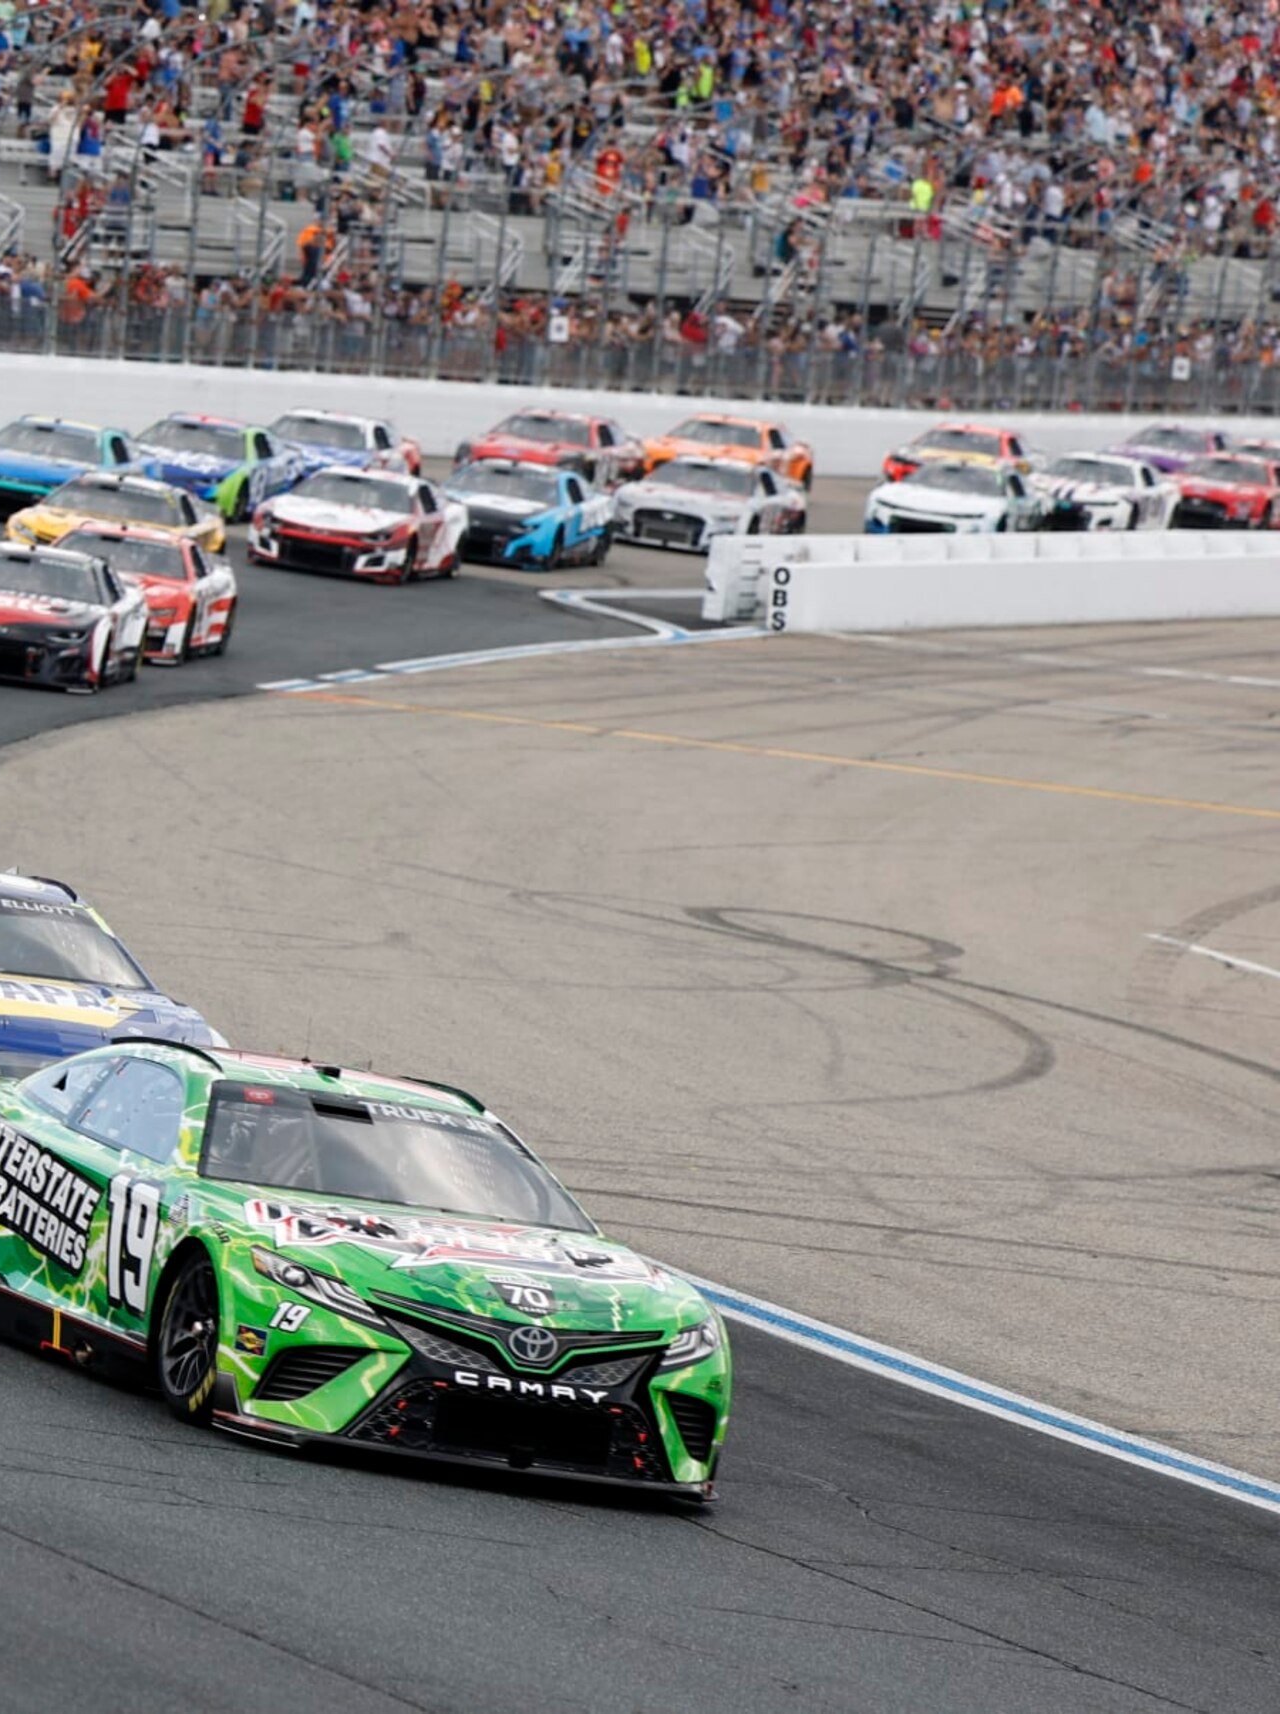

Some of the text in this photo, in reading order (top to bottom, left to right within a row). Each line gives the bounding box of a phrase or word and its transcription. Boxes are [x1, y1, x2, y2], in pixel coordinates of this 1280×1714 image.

[0, 898, 76, 918] ELLIOTT
[358, 1100, 458, 1129] TRUEX
[108, 1172, 161, 1314] 19
[501, 1284, 550, 1309] 70
[268, 1301, 312, 1331] 19
[454, 1370, 610, 1404] CAMRY
